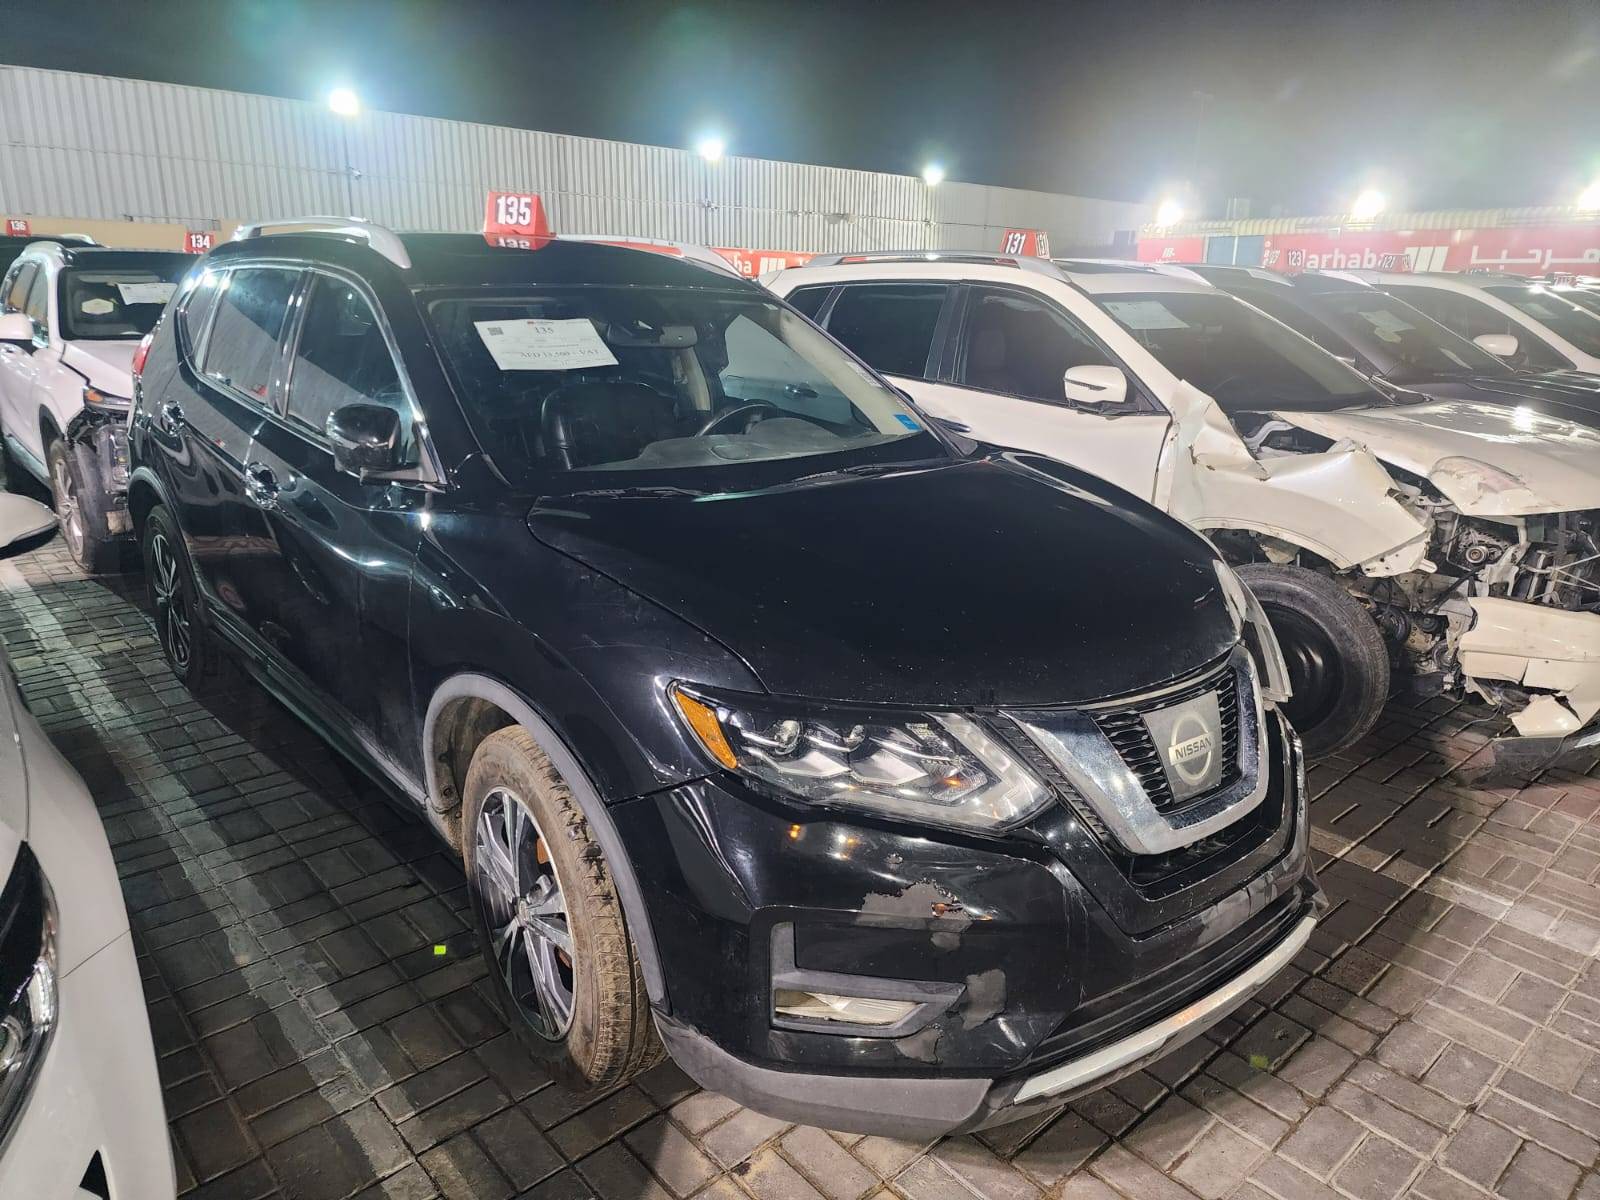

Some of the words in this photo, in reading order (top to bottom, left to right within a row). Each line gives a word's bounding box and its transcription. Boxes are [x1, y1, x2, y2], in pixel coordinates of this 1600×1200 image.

[497, 196, 531, 225] 135
[190, 234, 210, 249] 134
[1005, 232, 1026, 254] 131
[1288, 250, 1302, 266] 123
[1175, 737, 1212, 760] NISSAN
